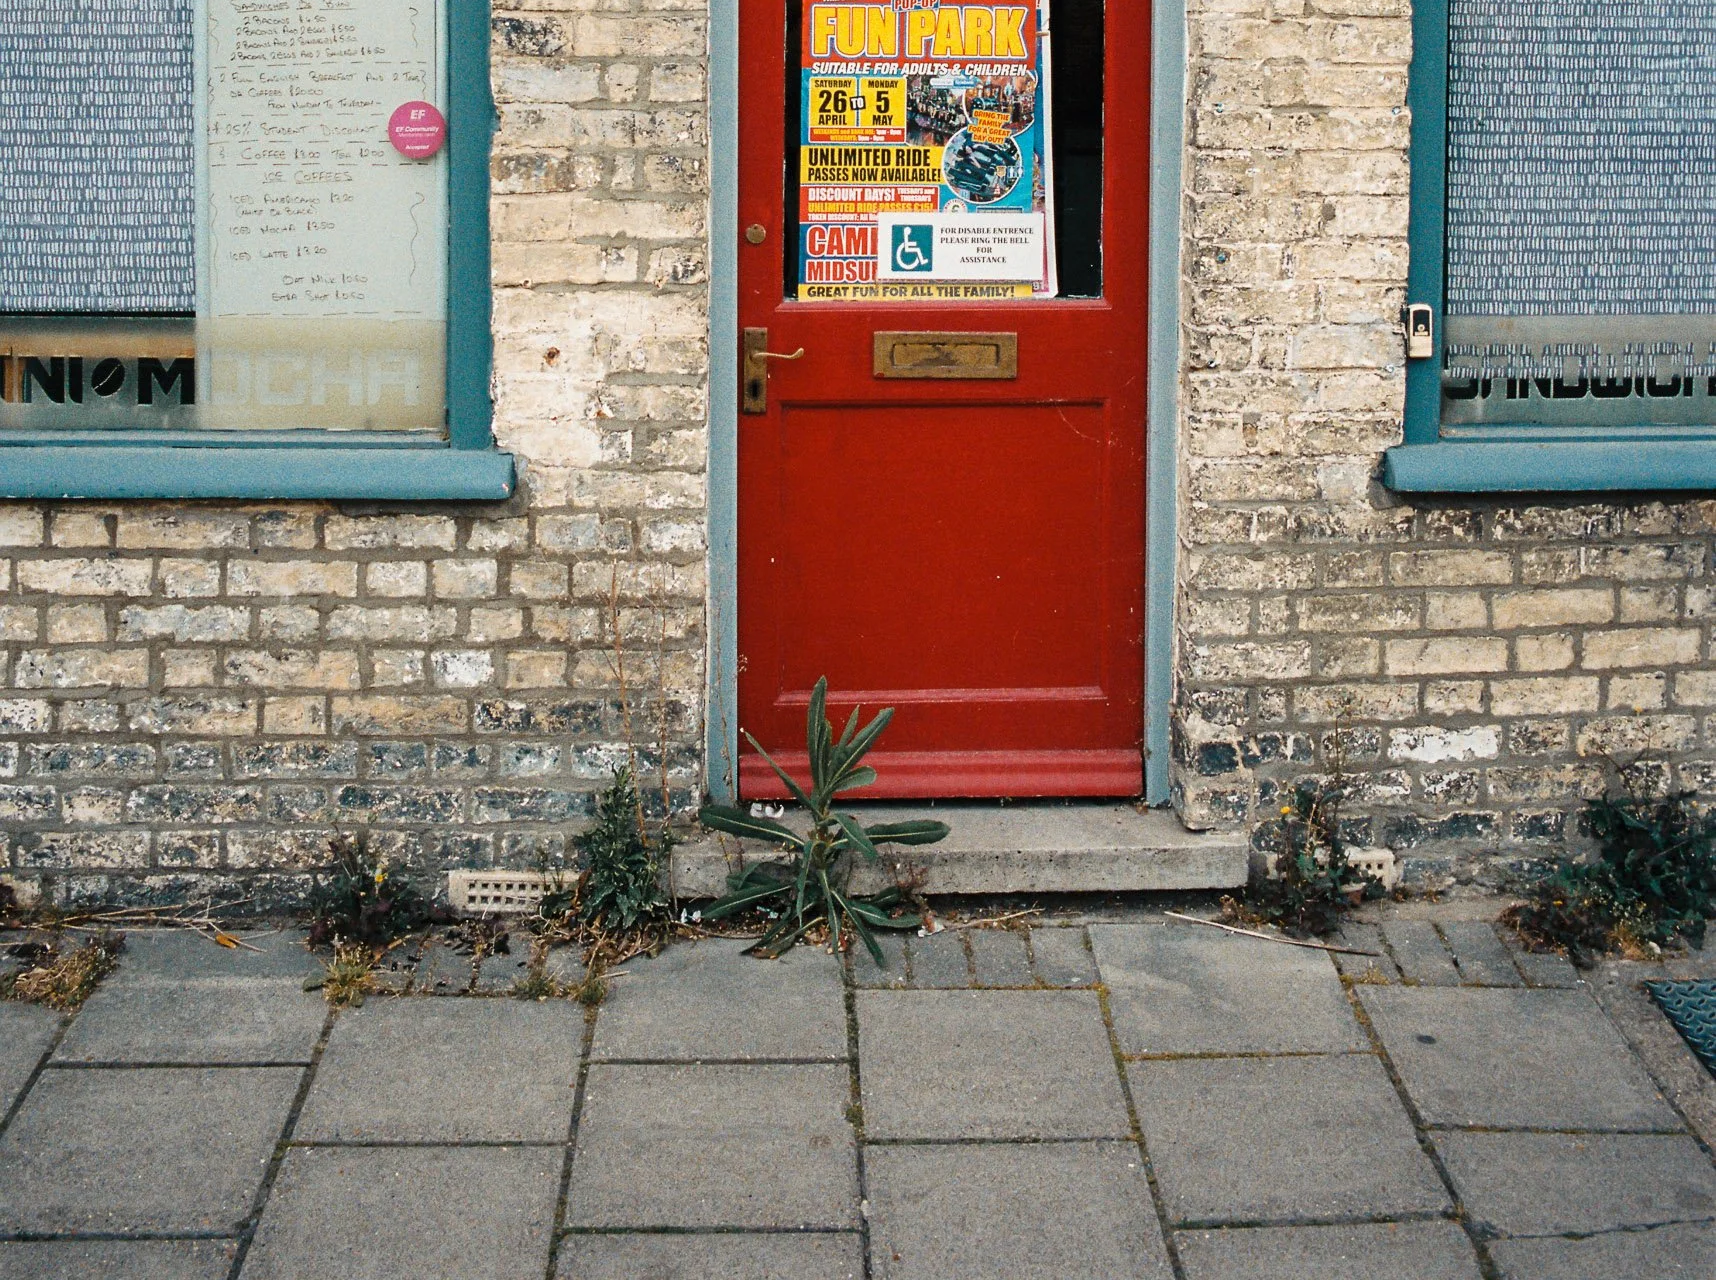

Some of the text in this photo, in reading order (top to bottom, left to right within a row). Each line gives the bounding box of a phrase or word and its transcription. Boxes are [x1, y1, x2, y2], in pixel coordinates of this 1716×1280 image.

[813, 6, 1026, 57] FUN PARK
[812, 62, 1027, 77] SUITABLE FOR ADULTS & CHILDREN
[815, 79, 898, 88] SATURDAY MONDAY
[818, 90, 889, 114] 26 TO 5
[410, 109, 426, 120] EF
[973, 110, 1010, 120] BRING THE
[818, 115, 893, 126] APRIL MAY
[977, 118, 1002, 128] FAMILY
[968, 125, 983, 133] FOR
[989, 127, 1011, 136] GREAT
[972, 134, 1004, 143] DAY OUT!
[809, 148, 930, 166] UNLIMITED RIDE
[808, 167, 941, 182] PASSES NOW AVAILABLE!
[808, 187, 895, 201] DISCOUNT DAYS!
[808, 202, 854, 212] UNLIMITED
[857, 202, 878, 212] RIDE
[941, 227, 1034, 235] FOR DISABLE ENTRENCE
[941, 236, 1029, 244] PLEASE RING THE BELL
[976, 246, 992, 254] FOR
[960, 256, 1007, 264] ASSISTANCE
[808, 286, 1015, 297] GREAT FUN FOR ALL THE FAMILY!
